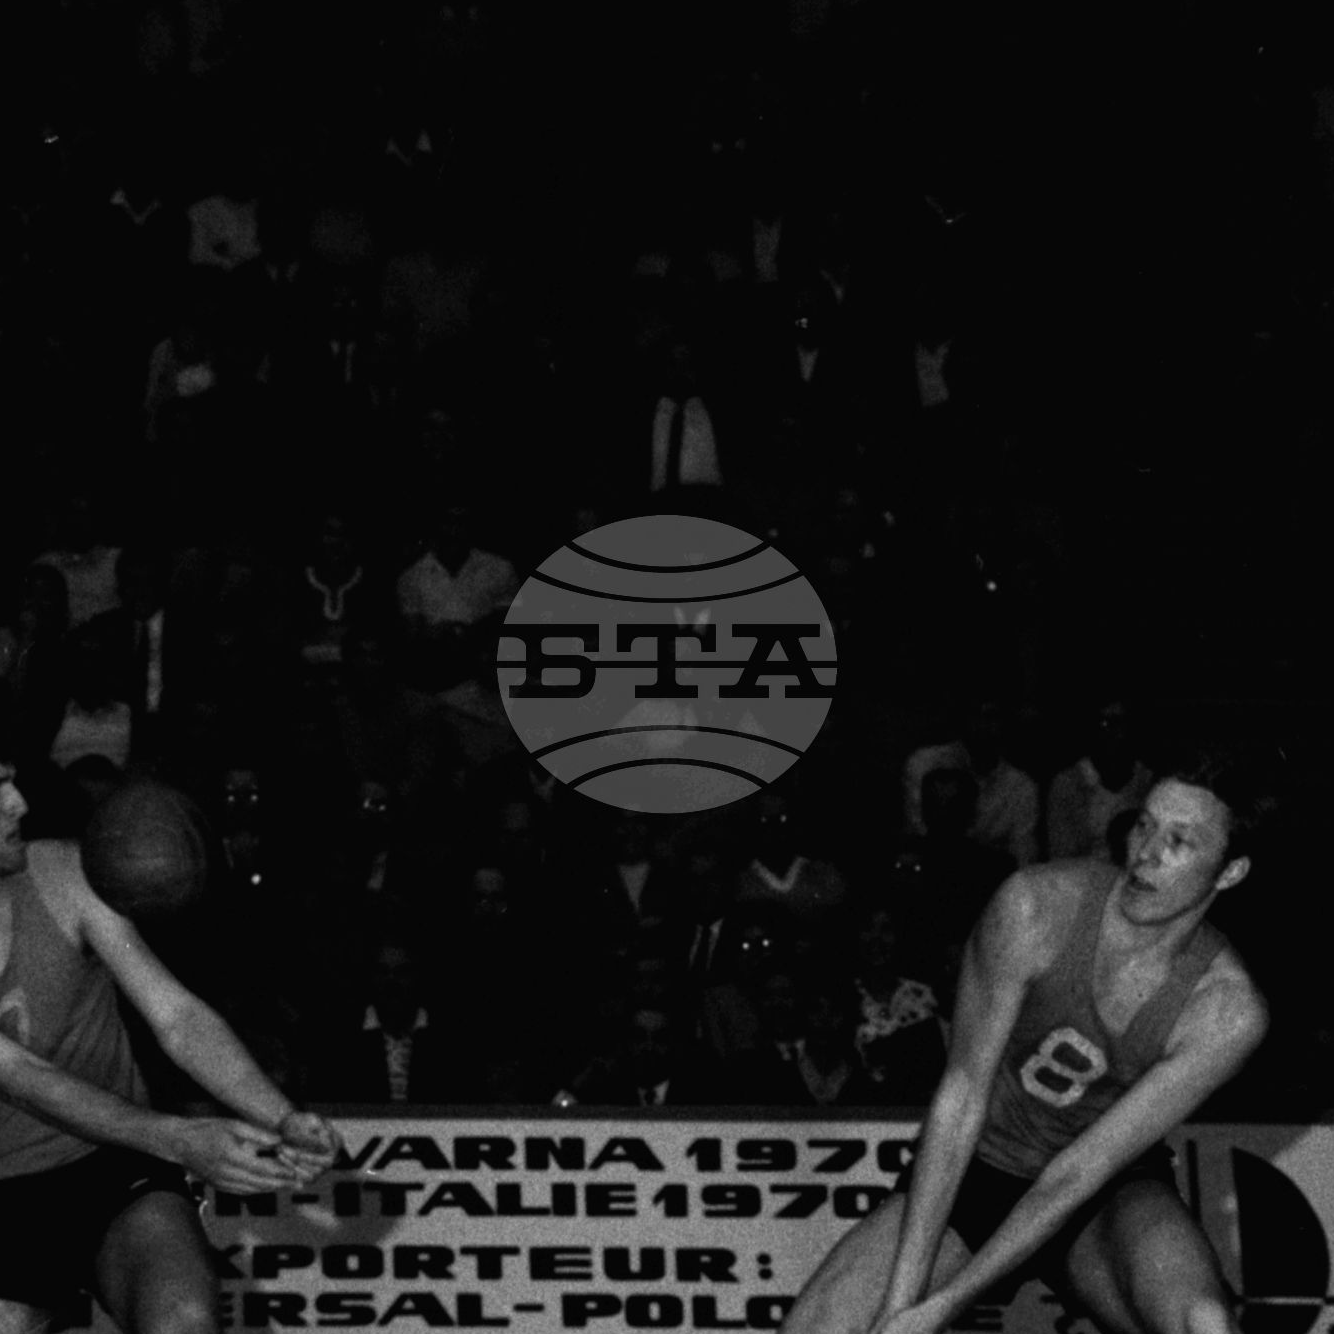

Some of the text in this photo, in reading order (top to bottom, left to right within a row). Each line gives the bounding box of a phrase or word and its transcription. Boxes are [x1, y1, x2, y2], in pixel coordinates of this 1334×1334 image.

[1020, 1026, 1108, 1108] 8
[333, 1137, 920, 1171] VARNA 1970
[653, 1183, 895, 1218] 1970
